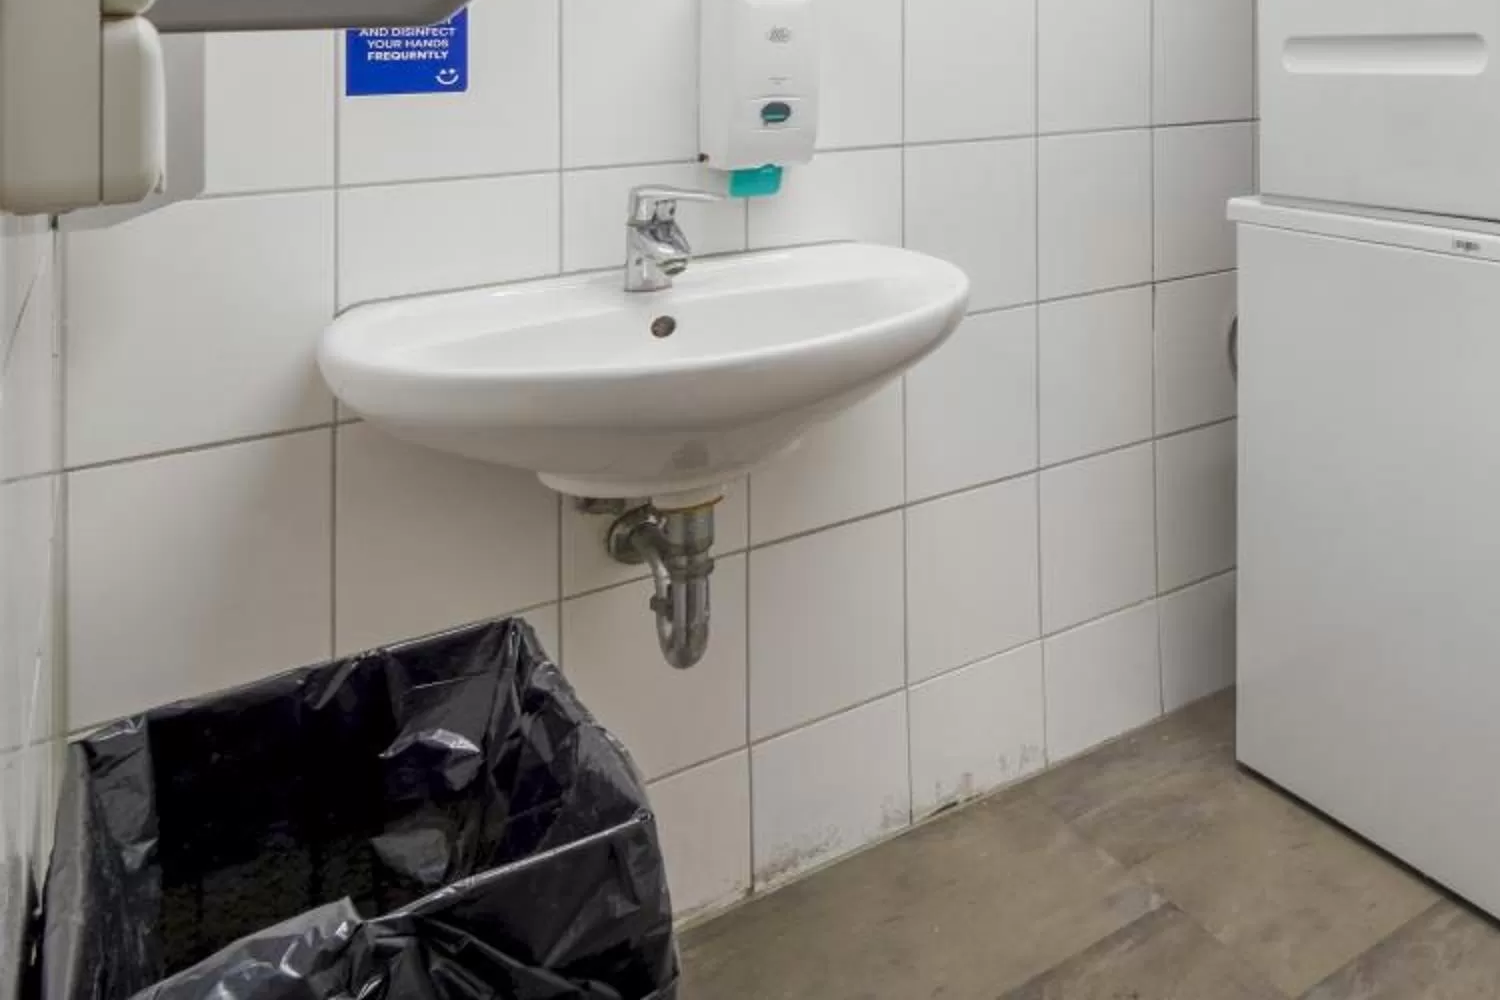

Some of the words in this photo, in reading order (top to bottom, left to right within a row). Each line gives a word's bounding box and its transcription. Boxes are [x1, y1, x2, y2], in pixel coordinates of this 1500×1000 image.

[359, 27, 388, 37] AND
[391, 27, 456, 37] DISINFECT
[367, 39, 402, 49] YOUR
[405, 39, 449, 49] HANDS
[367, 50, 449, 61] FREQUENTLY
